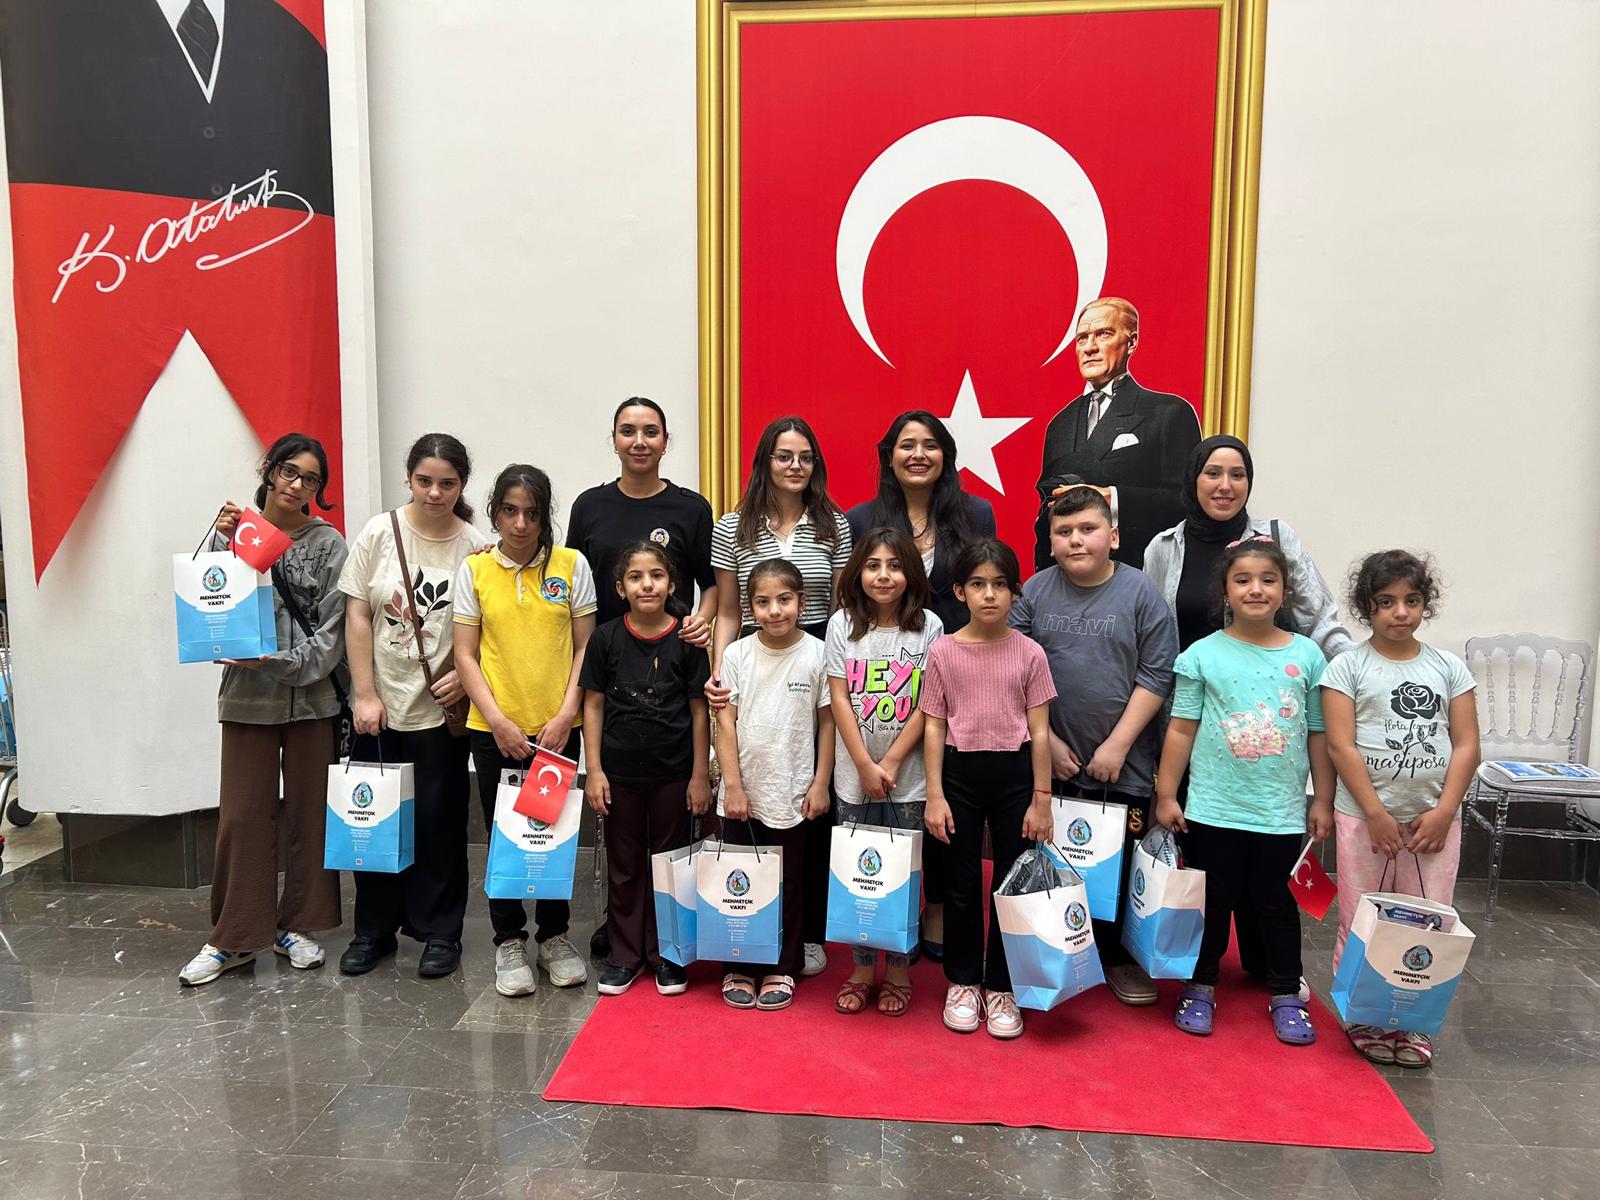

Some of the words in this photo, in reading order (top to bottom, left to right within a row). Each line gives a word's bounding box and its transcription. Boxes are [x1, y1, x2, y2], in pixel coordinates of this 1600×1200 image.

[1040, 613, 1117, 638] mavi
[1364, 753, 1447, 779] mariposa
[1400, 977, 1421, 985] VAKFI
